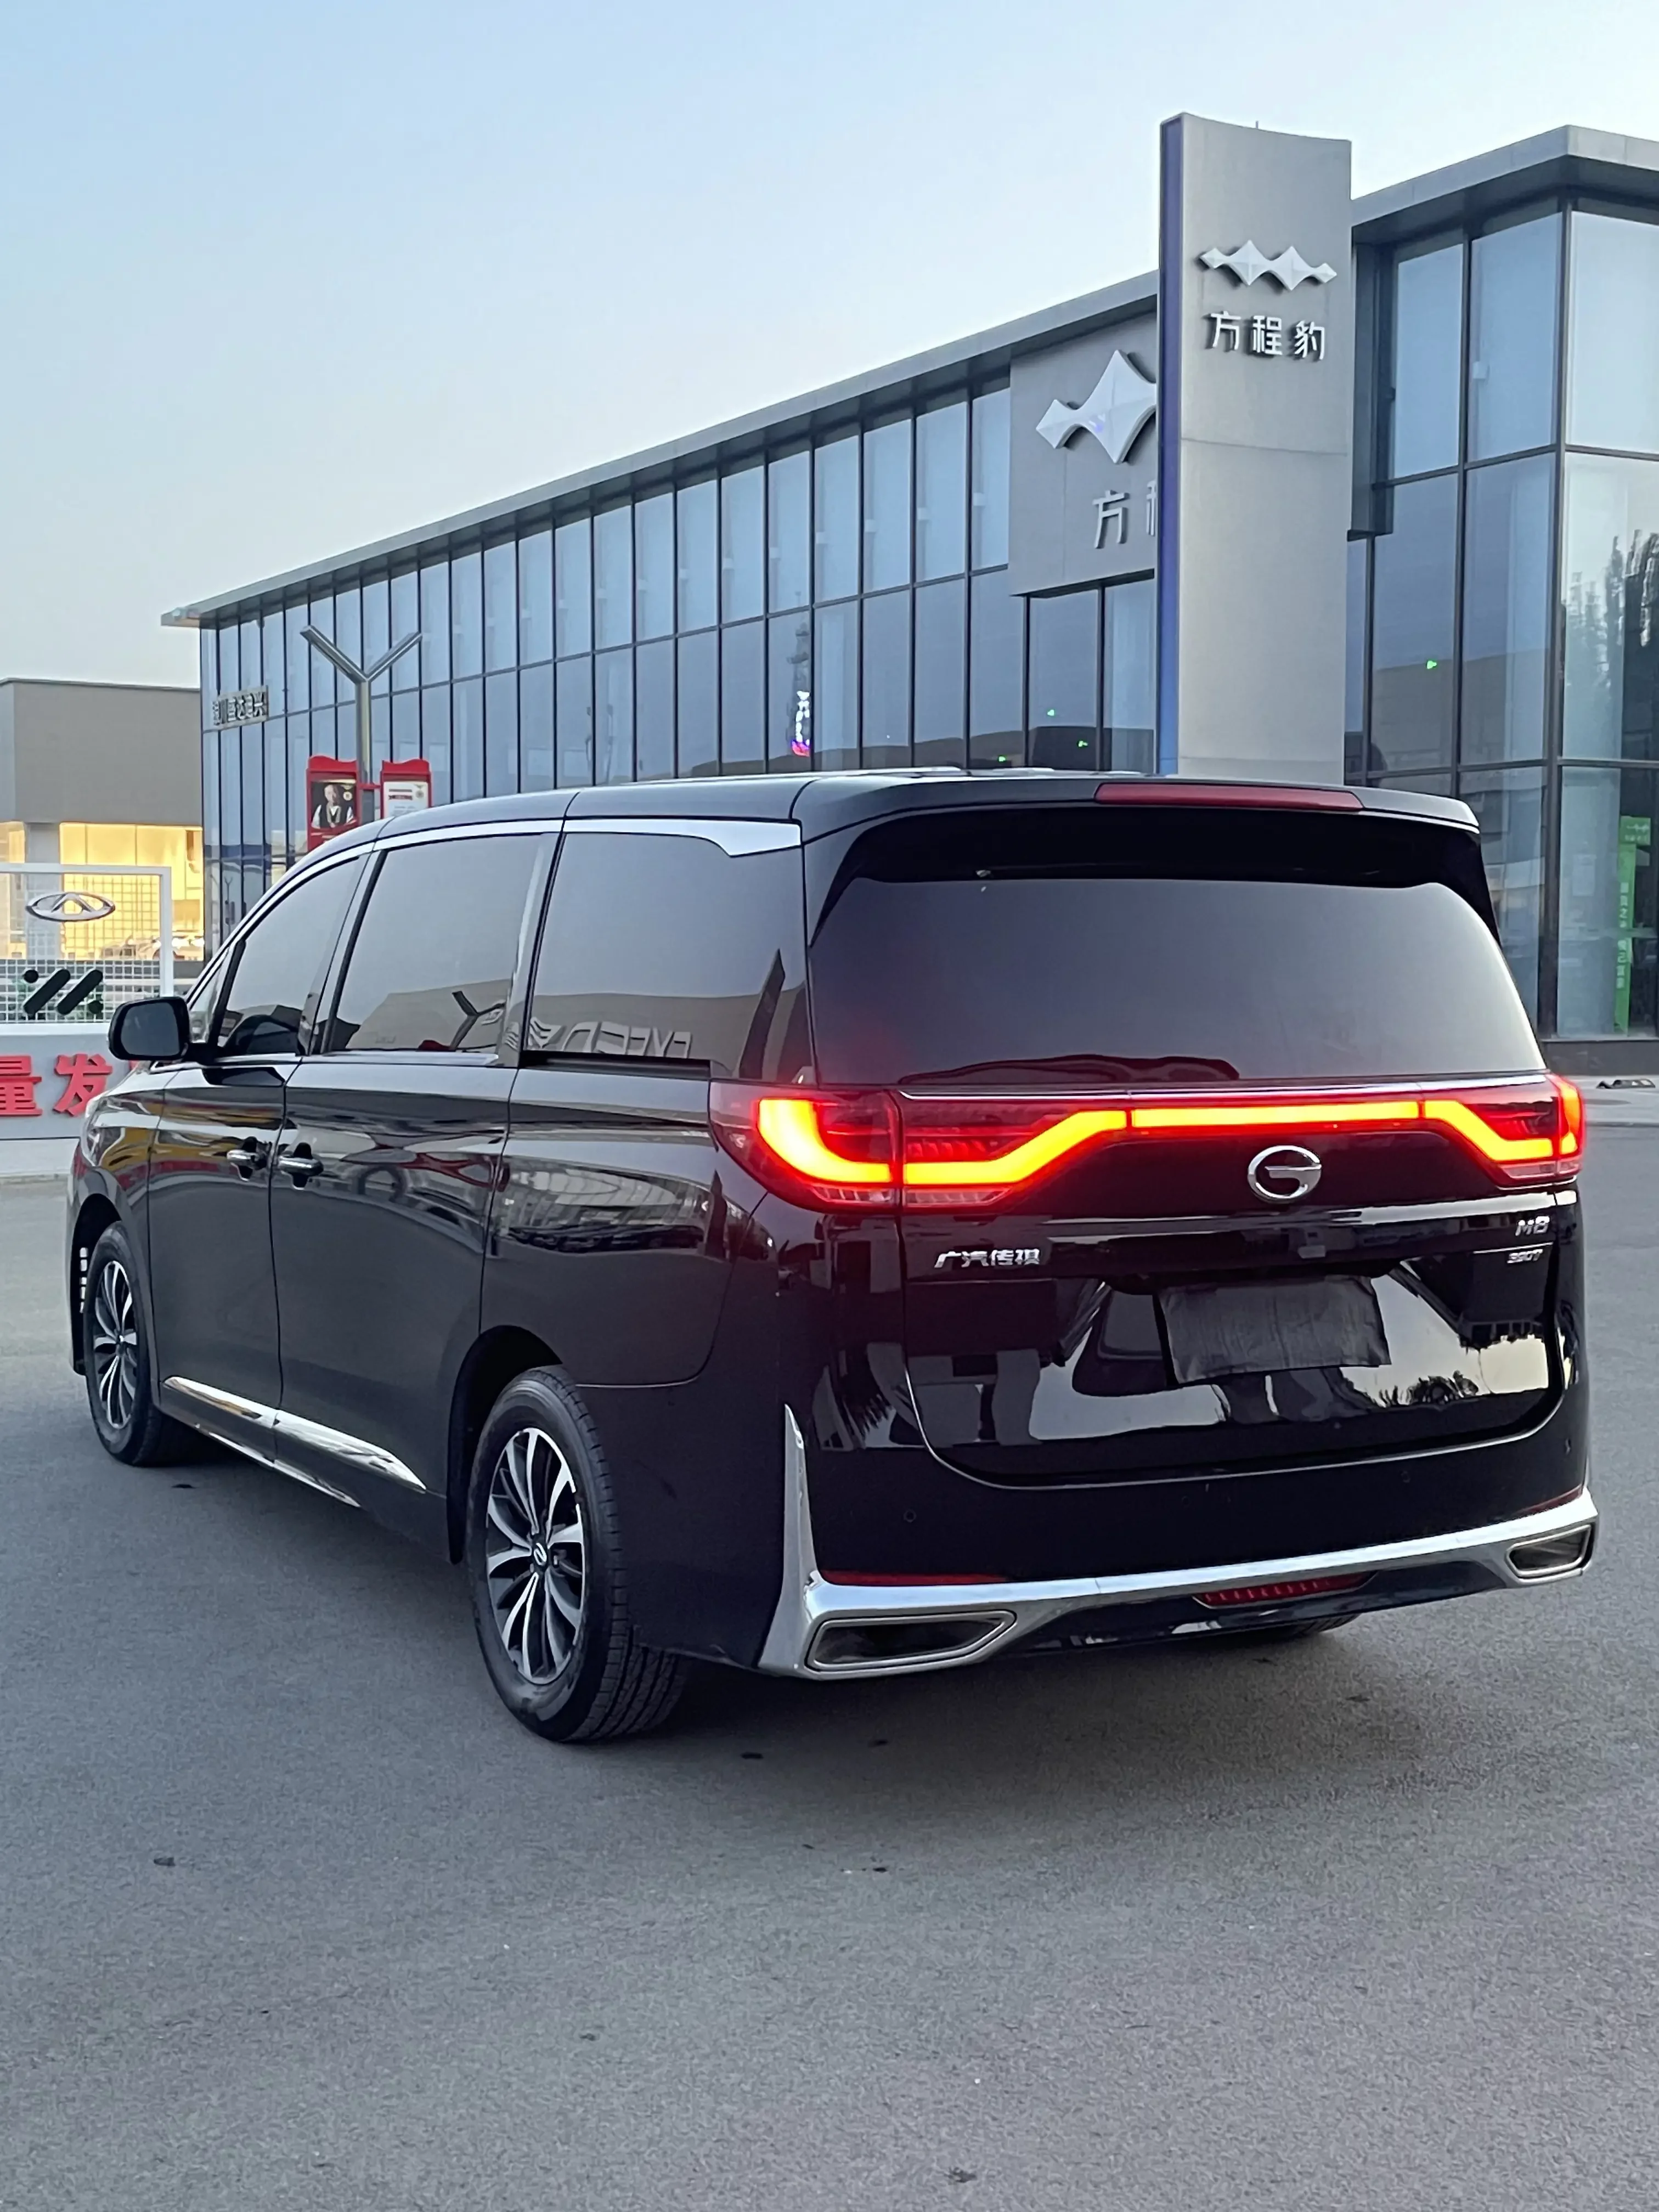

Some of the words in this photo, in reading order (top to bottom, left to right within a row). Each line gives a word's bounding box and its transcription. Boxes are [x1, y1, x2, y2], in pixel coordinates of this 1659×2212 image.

[1210, 311, 1325, 360] 方程豹
[0, 1053, 137, 1116] 量发
[1515, 1215, 1550, 1236] M8
[934, 1248, 1040, 1268] 广汽传祺
